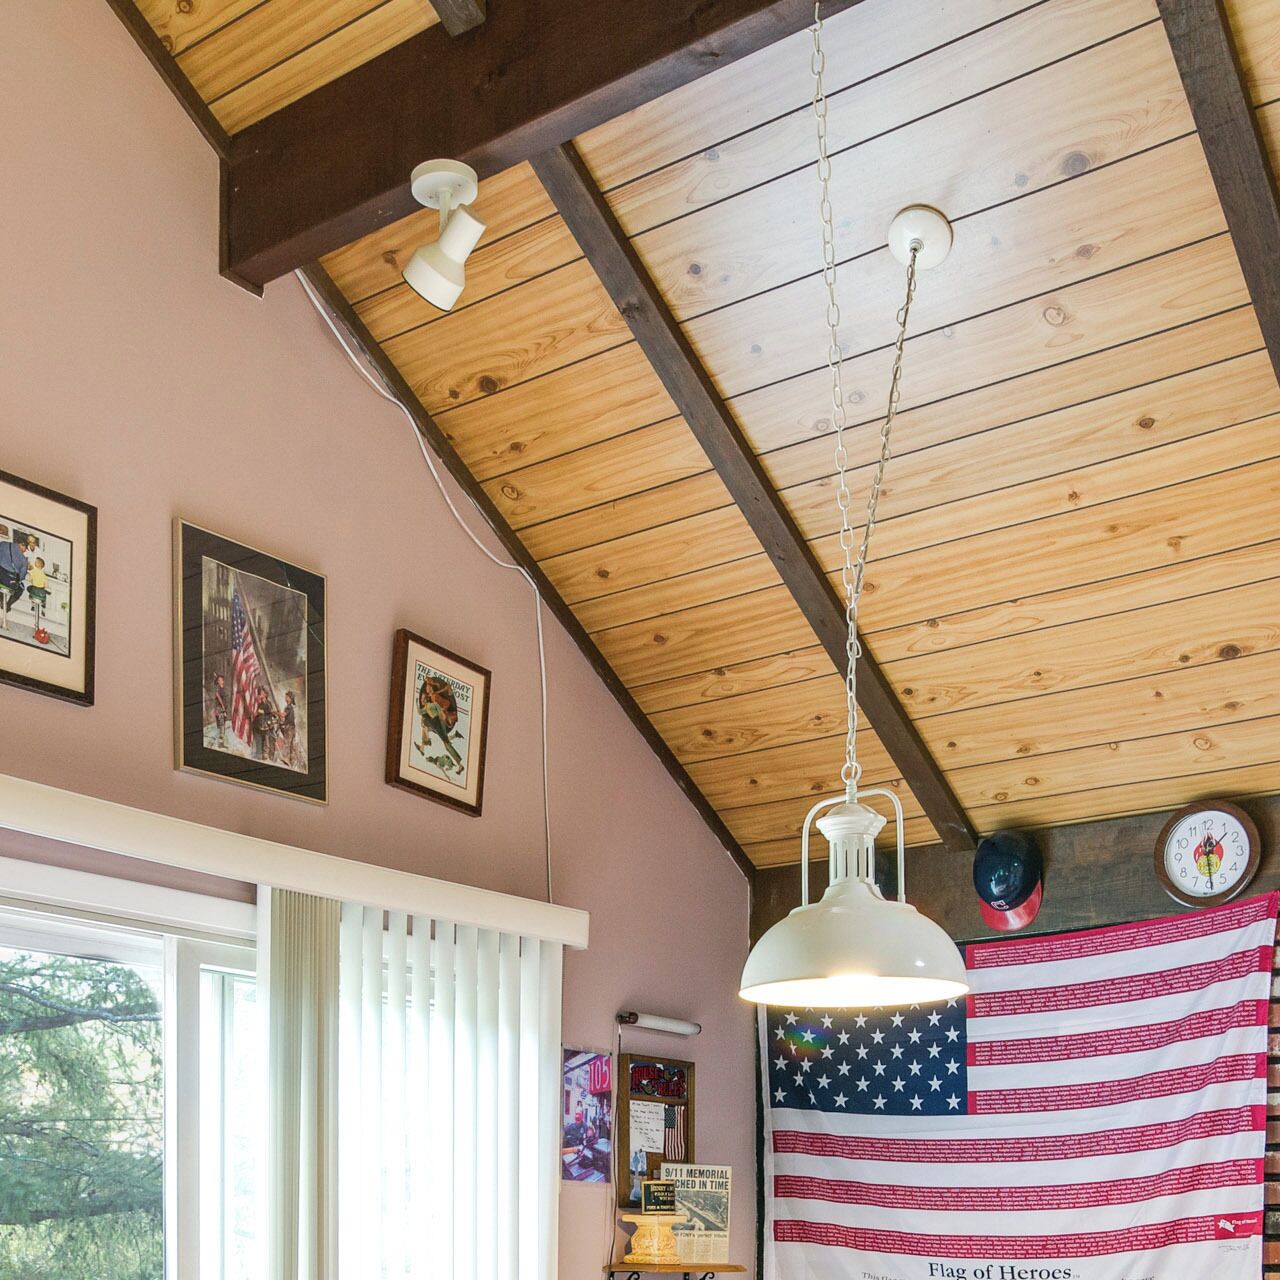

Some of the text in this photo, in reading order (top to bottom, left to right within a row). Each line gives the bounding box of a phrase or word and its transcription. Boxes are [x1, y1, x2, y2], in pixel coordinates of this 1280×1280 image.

[416, 663, 432, 676] THE
[433, 672, 471, 694] SATURDAY
[453, 690, 471, 703] OST
[1202, 819, 1214, 831] 12
[1222, 822, 1227, 833] 1
[1188, 826, 1198, 837] 11
[1231, 831, 1240, 843] 2
[1176, 837, 1189, 849] 10
[1235, 845, 1245, 857] 3
[1174, 852, 1183, 863] 9
[1179, 867, 1188, 878] 8
[1229, 862, 1238, 872] 4
[1192, 877, 1199, 888] 7
[1219, 873, 1227, 884] 5
[588, 1056, 610, 1092] 105
[664, 1167, 730, 1179] 9/11 MEMORIAL
[699, 1180, 708, 1189] IN
[710, 1180, 729, 1190] TIME
[862, 1272, 880, 1280] This
[973, 1264, 994, 1280] of
[999, 1265, 1072, 1280] Heroes
